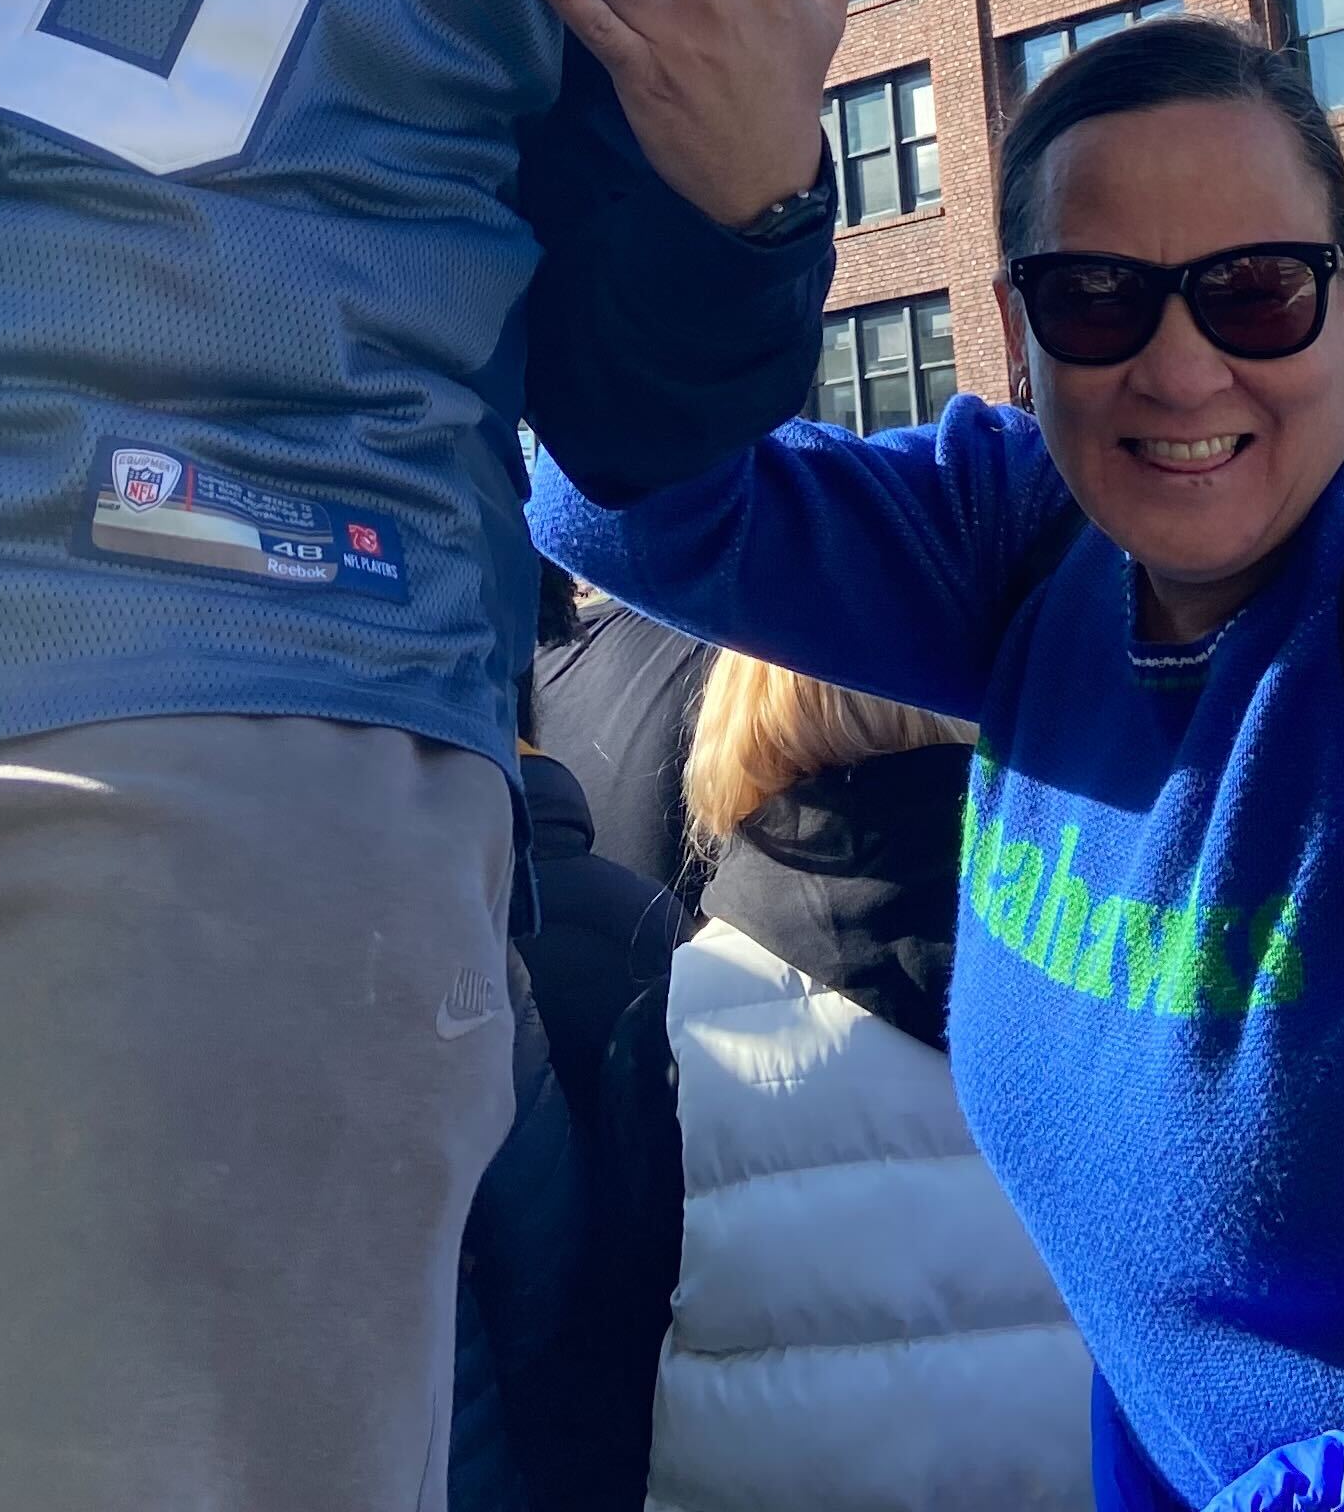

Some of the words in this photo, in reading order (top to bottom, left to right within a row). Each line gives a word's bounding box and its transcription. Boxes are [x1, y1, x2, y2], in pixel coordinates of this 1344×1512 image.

[128, 481, 155, 502] NFL
[273, 541, 323, 561] 48
[267, 557, 328, 579] Reebok
[343, 552, 360, 569] NFL
[361, 556, 398, 580] PLAYERS
